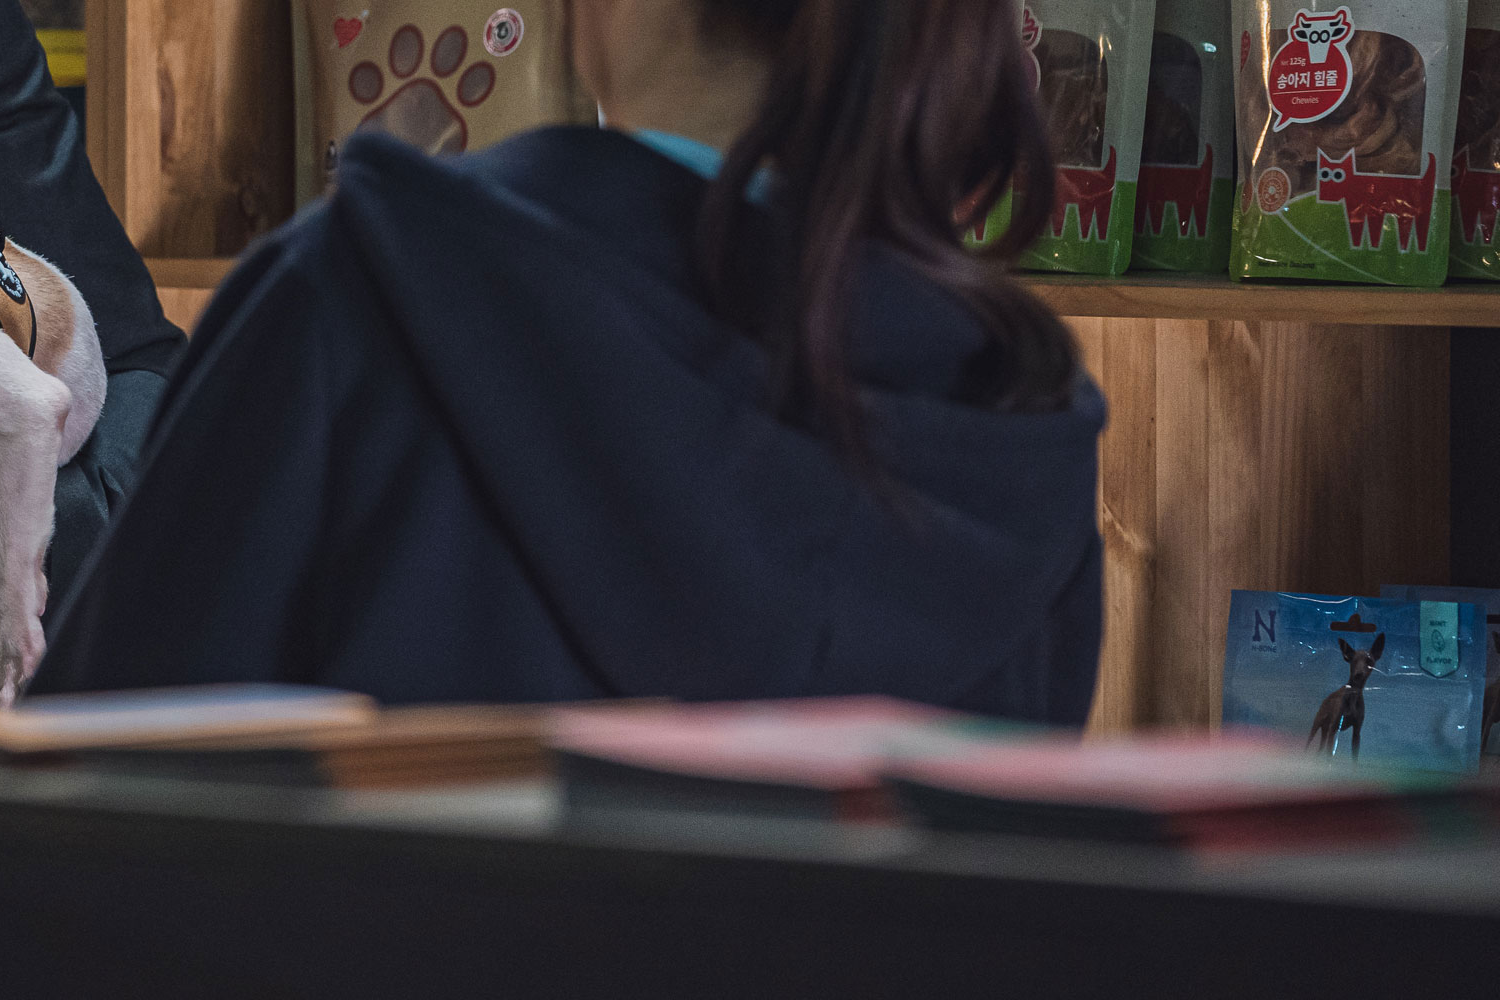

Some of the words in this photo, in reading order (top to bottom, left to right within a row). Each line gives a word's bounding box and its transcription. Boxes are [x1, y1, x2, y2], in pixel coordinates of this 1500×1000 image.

[1289, 57, 1306, 67] 125g
[1276, 72, 1310, 89] 송아지
[1314, 70, 1338, 88] 힘줄
[1291, 96, 1319, 106] Chewies
[1252, 609, 1276, 643] N
